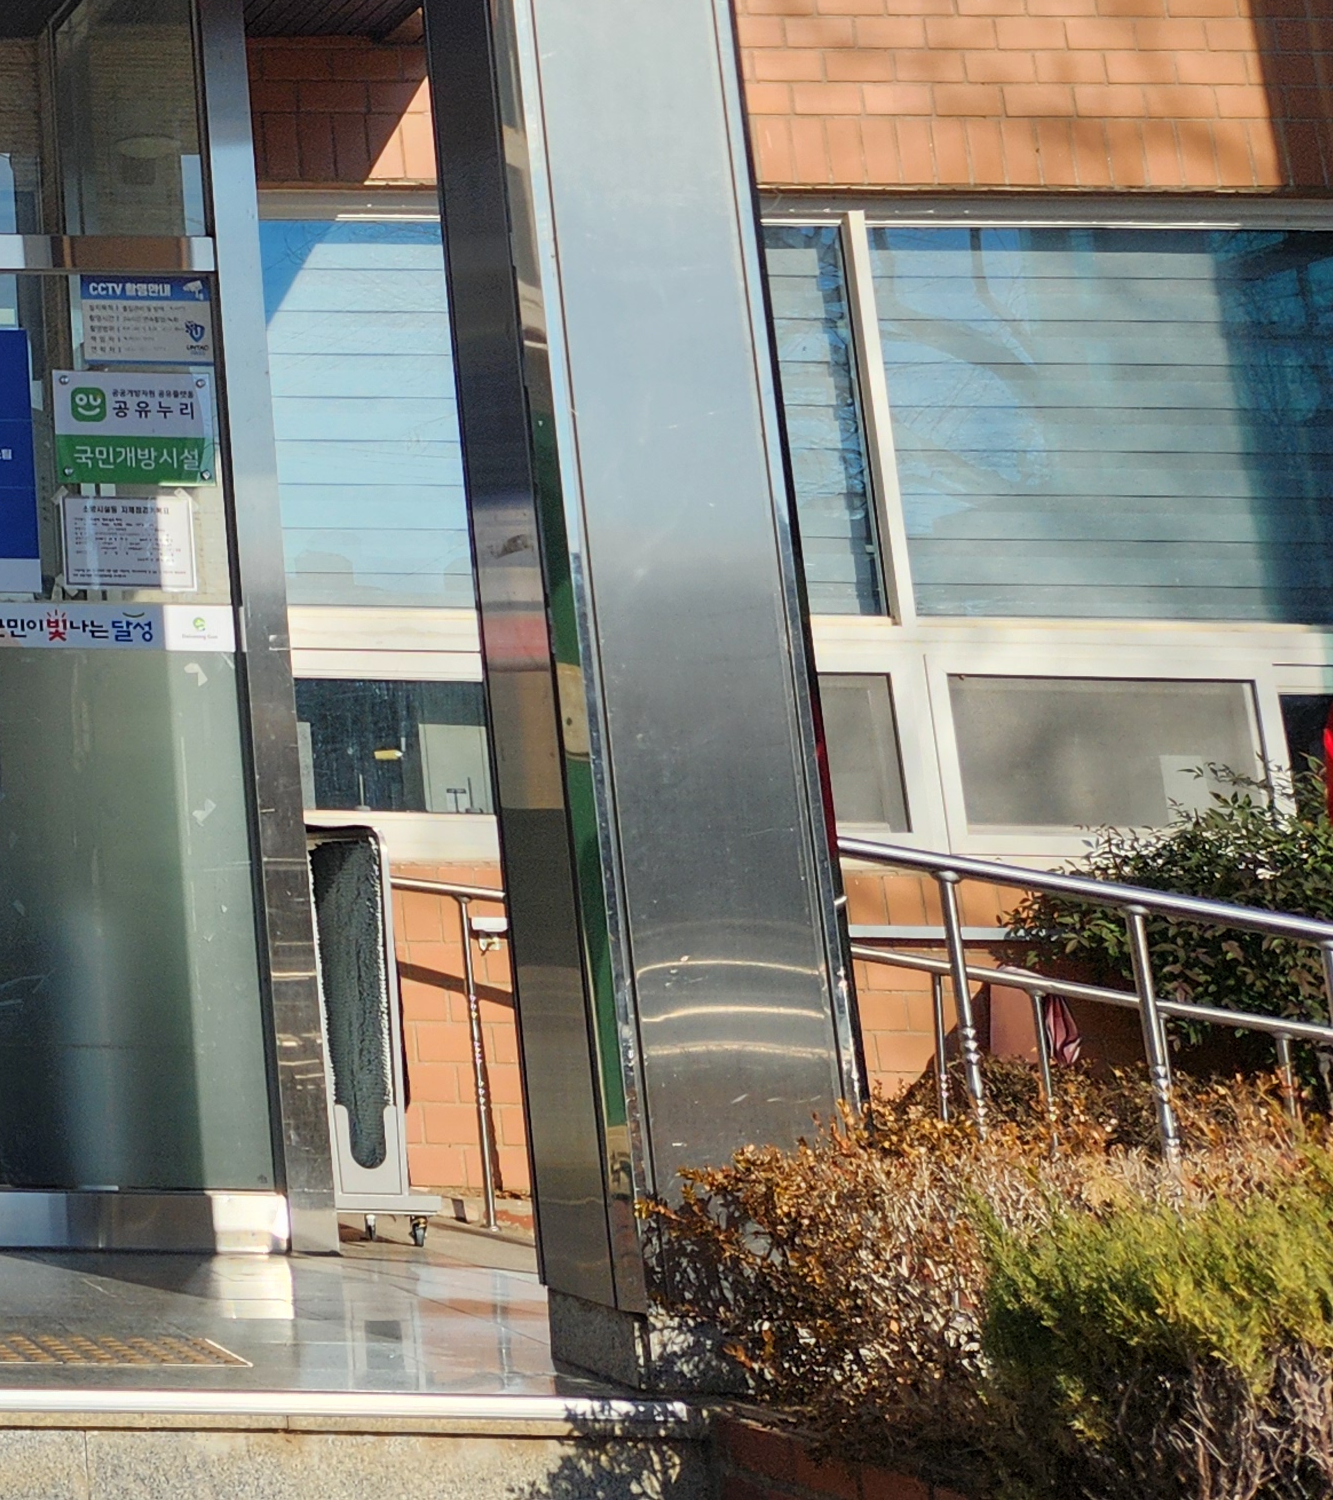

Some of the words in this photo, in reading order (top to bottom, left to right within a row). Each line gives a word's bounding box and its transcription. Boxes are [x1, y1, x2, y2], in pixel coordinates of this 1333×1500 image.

[89, 282, 123, 296] CCTV
[111, 388, 156, 399] 공공개방자원
[112, 400, 195, 420] 공유누리
[73, 445, 201, 471] 국민개방시설
[46, 616, 110, 642] 빛나는
[110, 618, 154, 643] 달성
